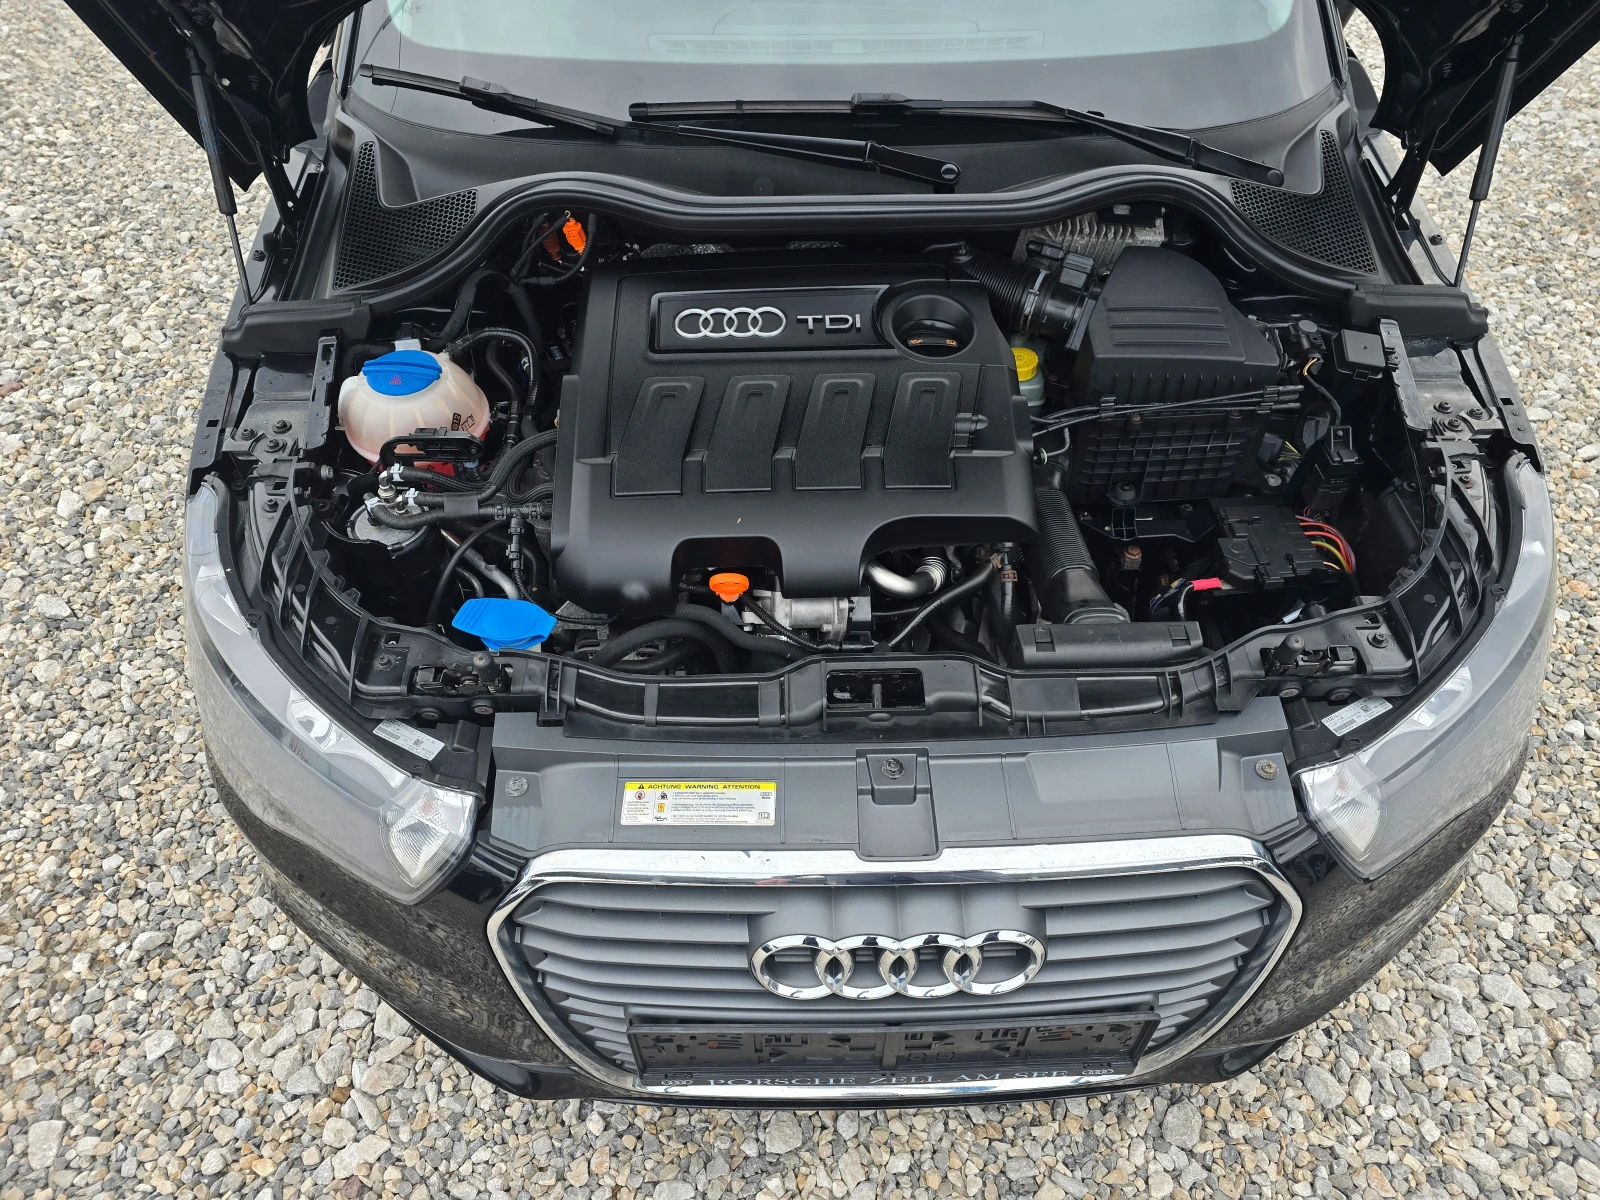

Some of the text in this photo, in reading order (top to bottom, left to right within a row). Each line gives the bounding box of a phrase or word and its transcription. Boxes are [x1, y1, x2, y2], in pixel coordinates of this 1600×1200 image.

[797, 313, 861, 332] TDI
[707, 1071, 1068, 1086] PORSCHE ZELL AM SEE
